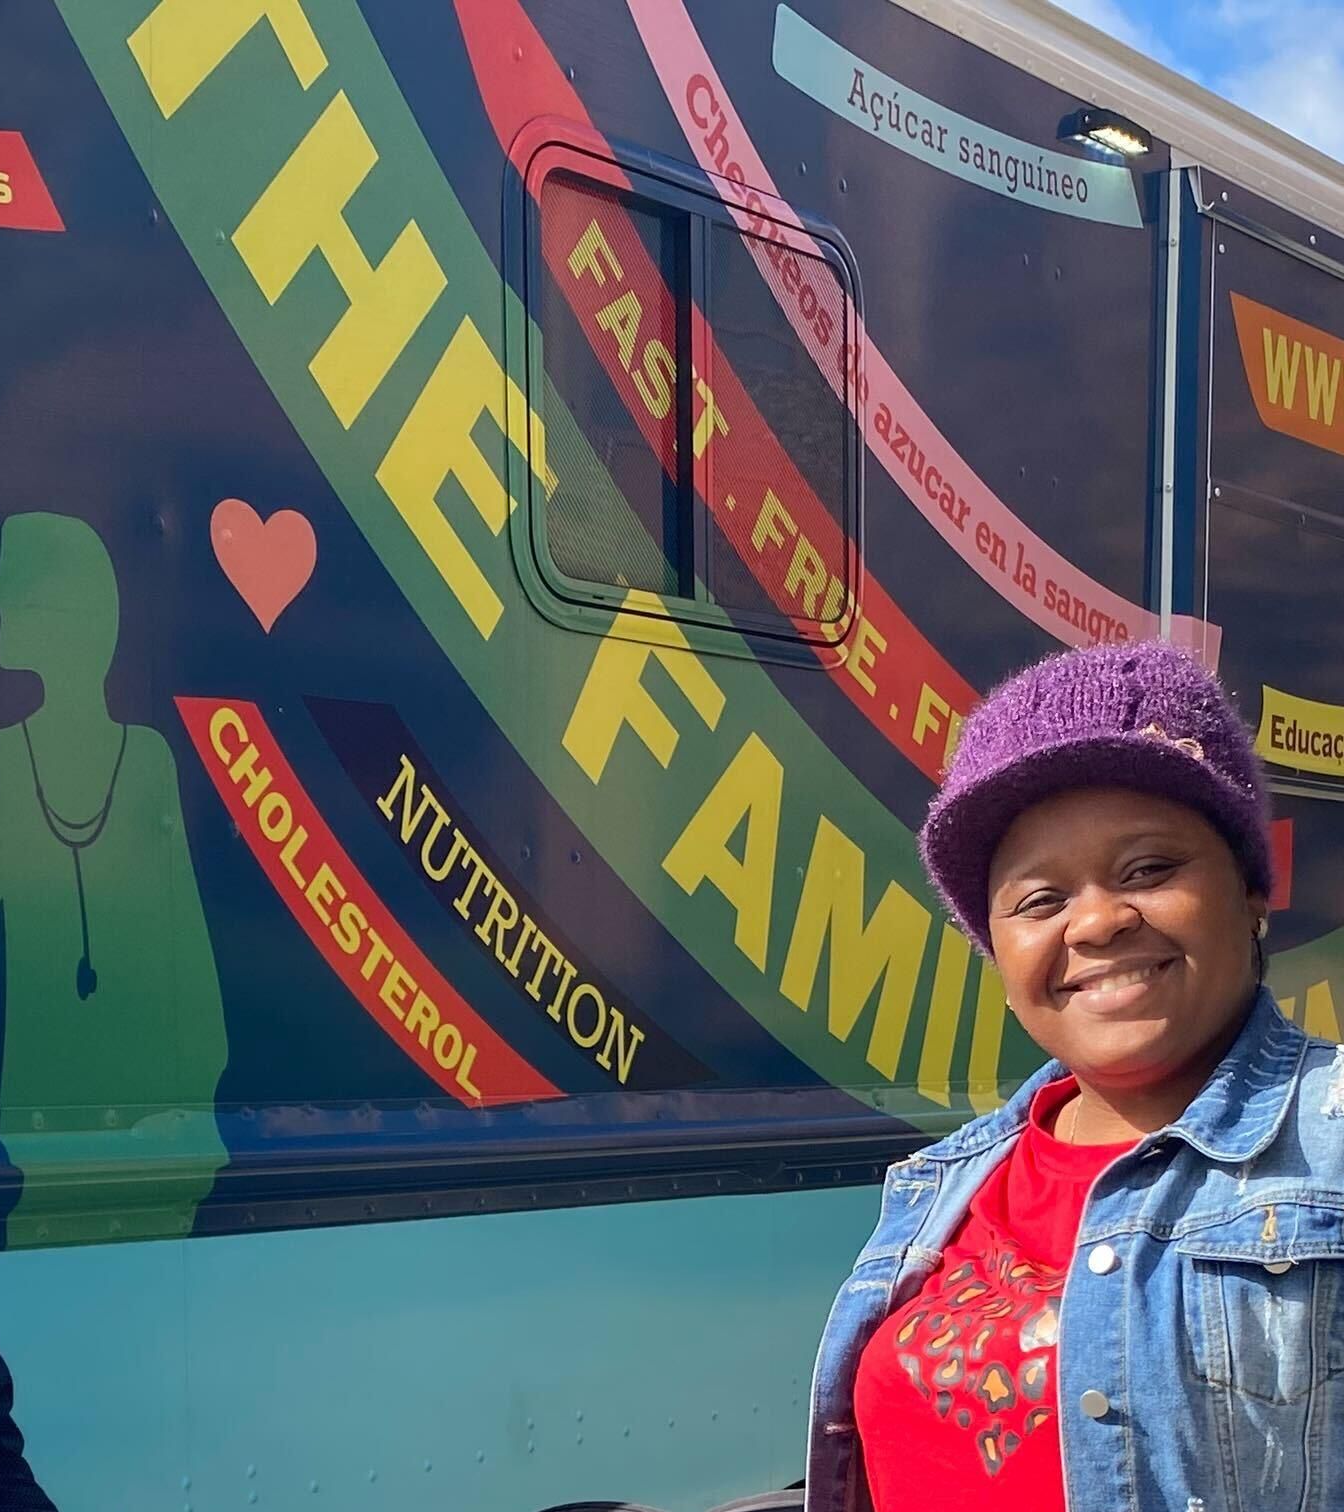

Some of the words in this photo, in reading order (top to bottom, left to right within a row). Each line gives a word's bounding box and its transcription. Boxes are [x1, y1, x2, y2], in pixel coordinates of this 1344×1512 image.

[847, 68, 949, 158] Açúcar
[957, 134, 1090, 203] sanguíneo
[568, 219, 731, 462] FAST
[751, 488, 888, 698] FREE
[874, 402, 971, 533] azucar
[975, 520, 1006, 574] en
[1012, 541, 1037, 598] la
[1044, 577, 1129, 648] sangre
[209, 707, 482, 1099] CHOLESTEROL
[376, 755, 645, 1085] NUTRITION
[560, 574, 1008, 1118] FAMIL
